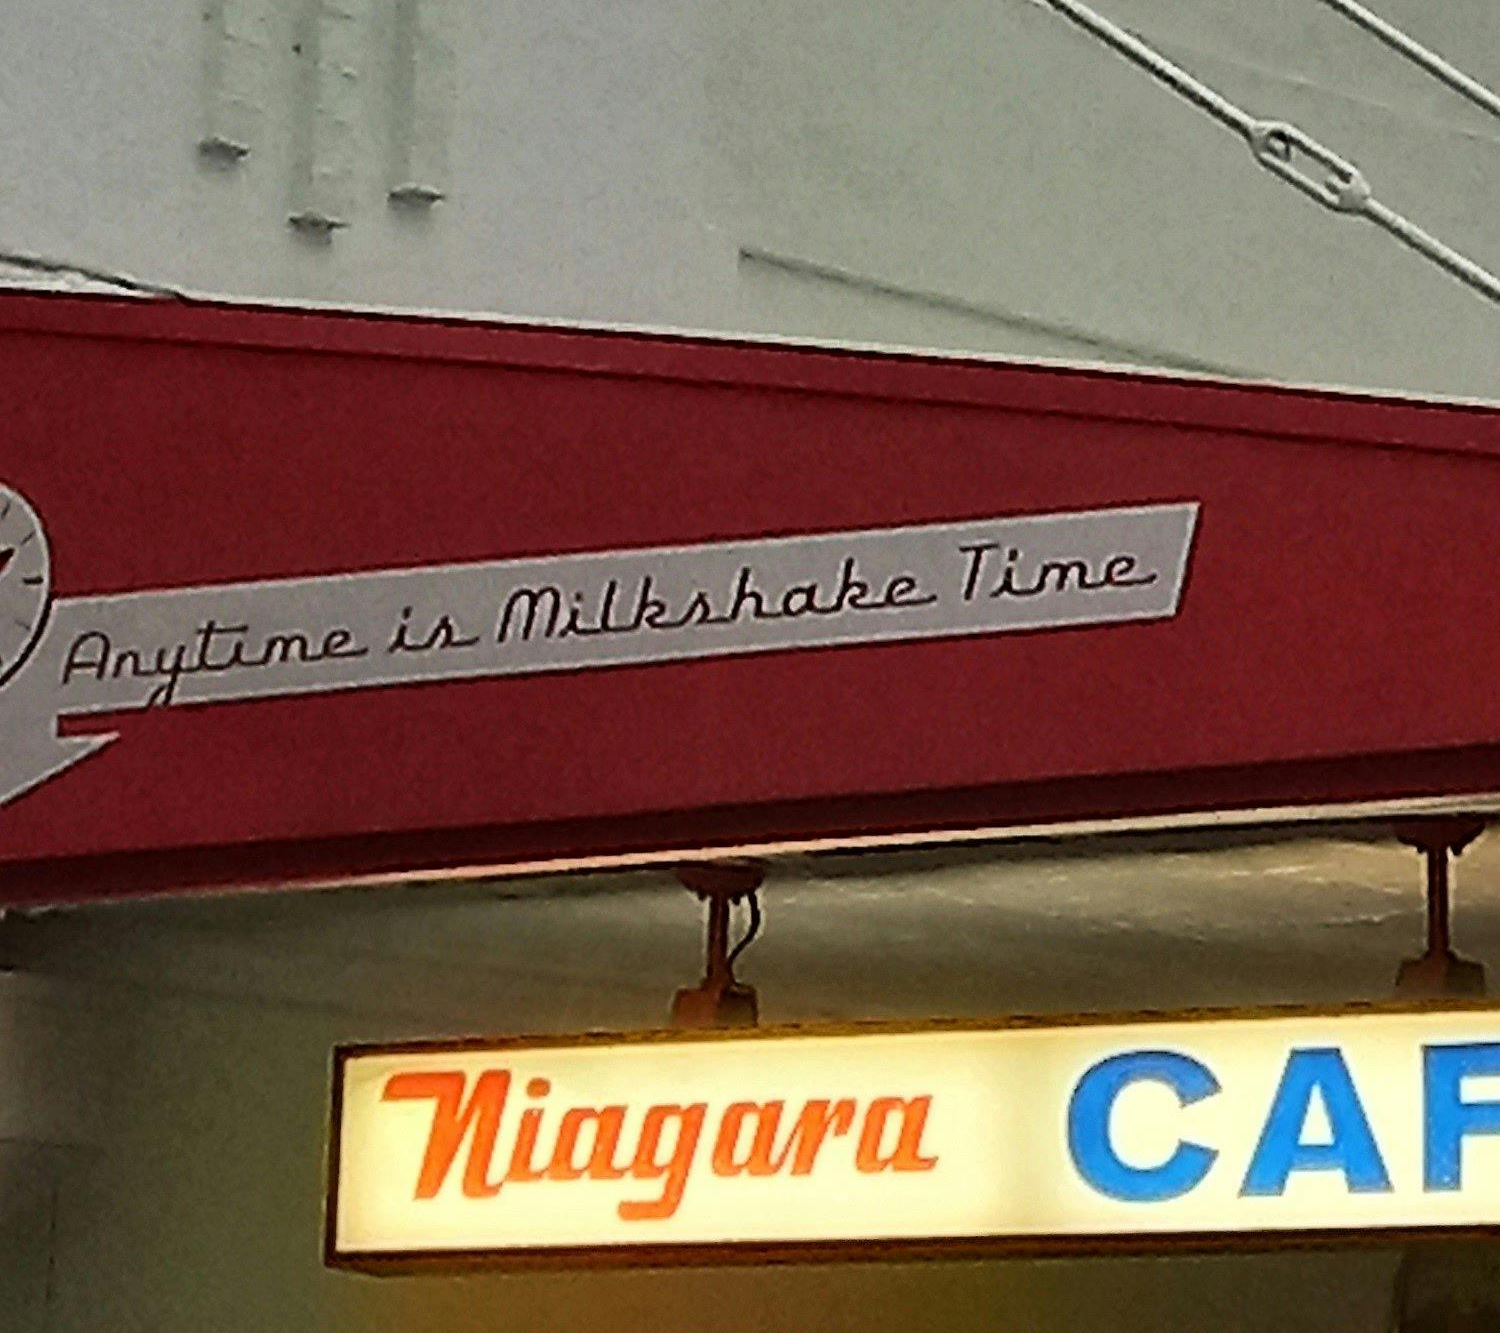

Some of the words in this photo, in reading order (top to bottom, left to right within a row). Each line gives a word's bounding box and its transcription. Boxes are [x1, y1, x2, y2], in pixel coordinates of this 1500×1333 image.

[62, 620, 368, 707] Anytime
[391, 601, 479, 653] is
[496, 558, 937, 646] Milkshake
[957, 541, 1158, 601] Time
[381, 1067, 941, 1222] Niagara
